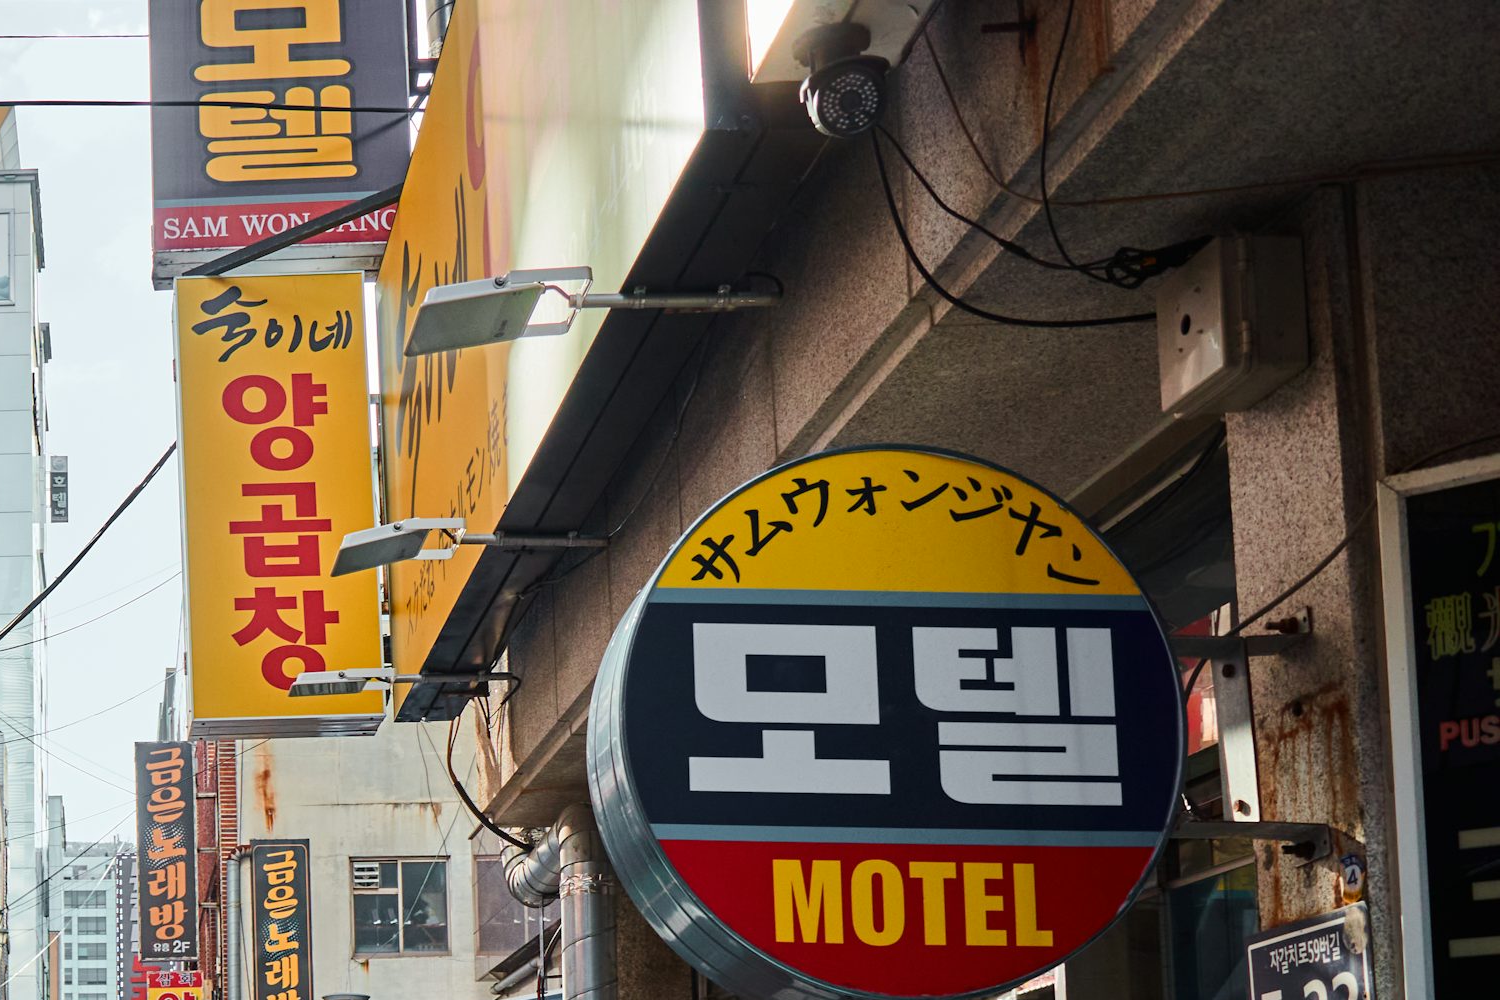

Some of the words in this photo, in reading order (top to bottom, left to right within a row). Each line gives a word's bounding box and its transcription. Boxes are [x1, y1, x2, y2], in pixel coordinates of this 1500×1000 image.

[164, 215, 228, 240] SAM
[192, 285, 353, 363] 숙이네
[221, 371, 339, 693] 양곱창
[688, 622, 1123, 806] 모텔
[772, 858, 1054, 948] MOTEL
[1346, 868, 1359, 885] 4
[172, 939, 190, 953] 2F
[1269, 931, 1341, 975] 자갈치로59번길
